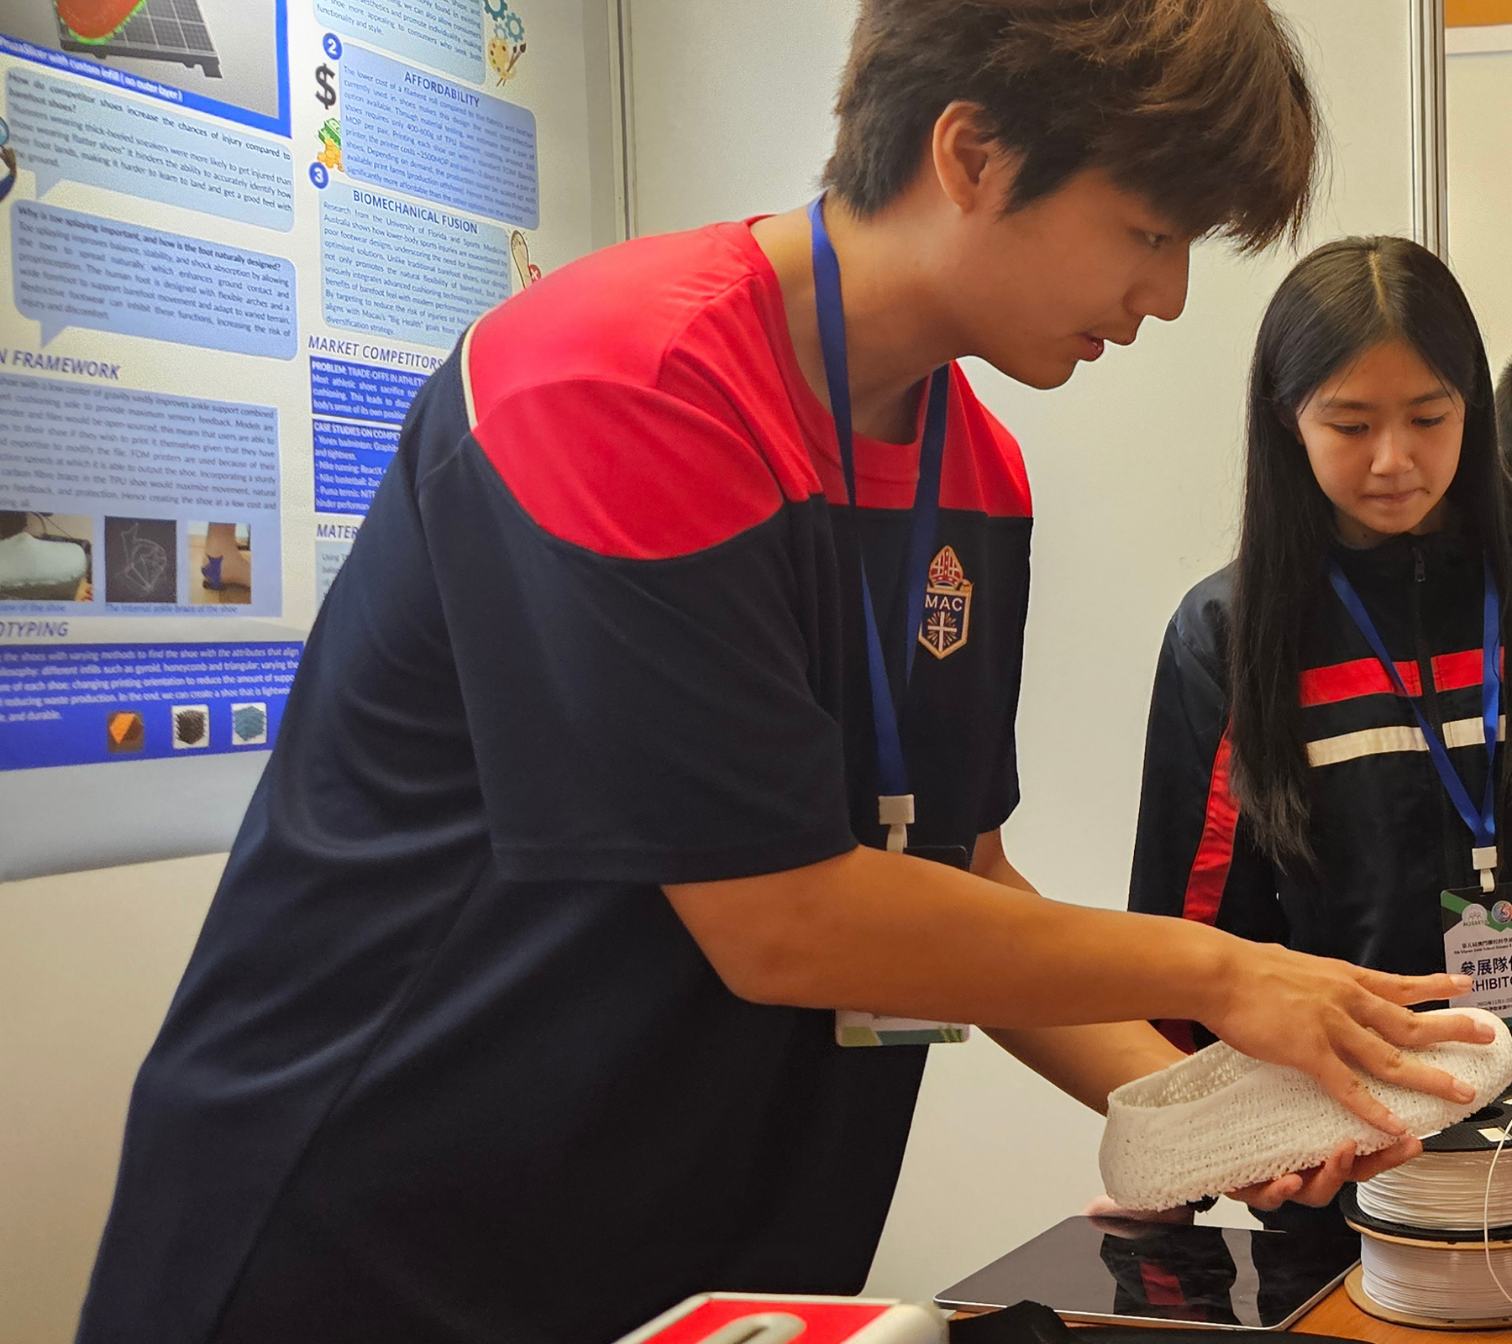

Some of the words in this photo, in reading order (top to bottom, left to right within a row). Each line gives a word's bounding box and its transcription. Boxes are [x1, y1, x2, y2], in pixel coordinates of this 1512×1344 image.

[404, 70, 479, 108] AFFORDABILITY
[353, 189, 439, 224] BIOMECHANICAL
[442, 213, 477, 234] FUSION
[13, 349, 121, 380] FRAMEWORK
[308, 335, 359, 356] MARKET
[362, 345, 443, 372] COMPETITORS
[924, 594, 963, 612] MAC
